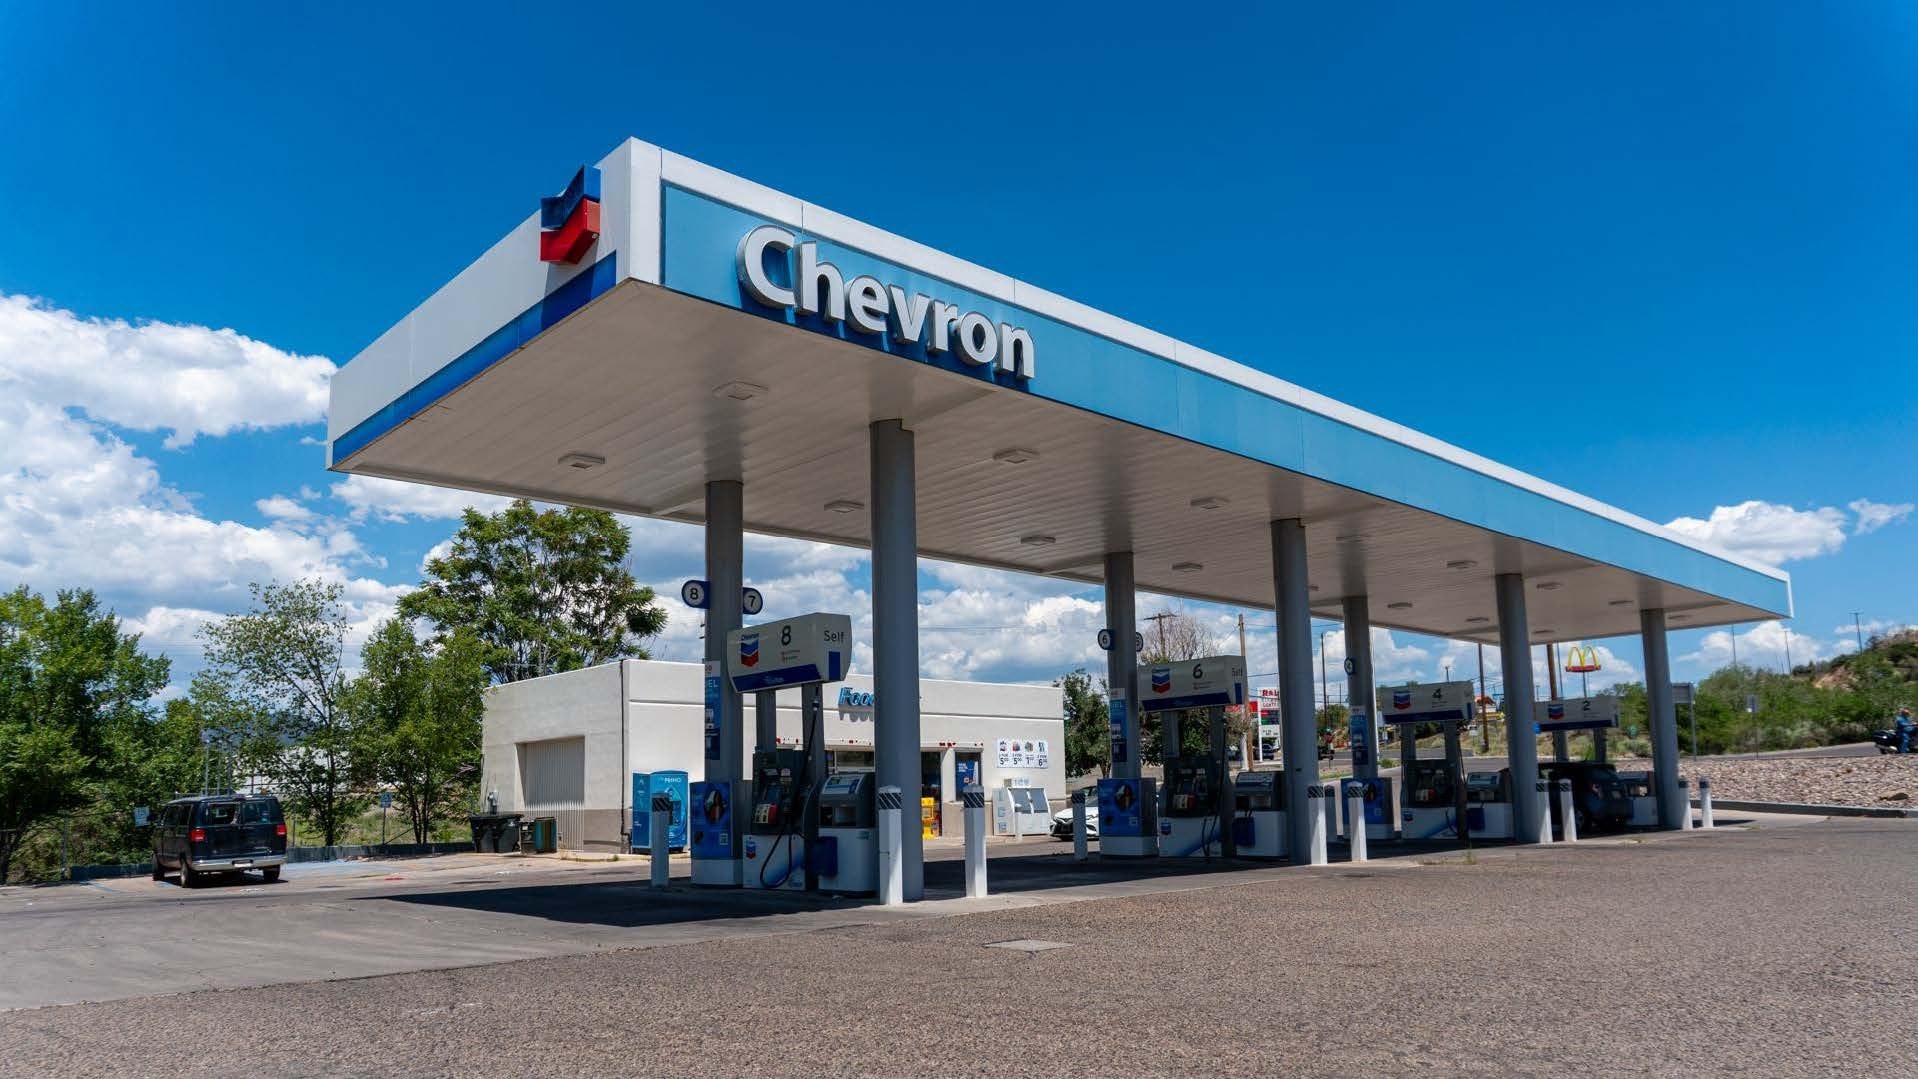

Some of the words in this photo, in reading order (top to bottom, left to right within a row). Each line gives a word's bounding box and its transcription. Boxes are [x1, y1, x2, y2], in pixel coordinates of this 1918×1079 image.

[736, 224, 1035, 380] Chevron
[689, 587, 699, 600] 8
[748, 595, 756, 608] 7
[781, 625, 792, 646] 8
[824, 630, 845, 643] Self
[1192, 663, 1203, 679] 6
[1432, 688, 1442, 700] 4
[1583, 700, 1591, 711] 2
